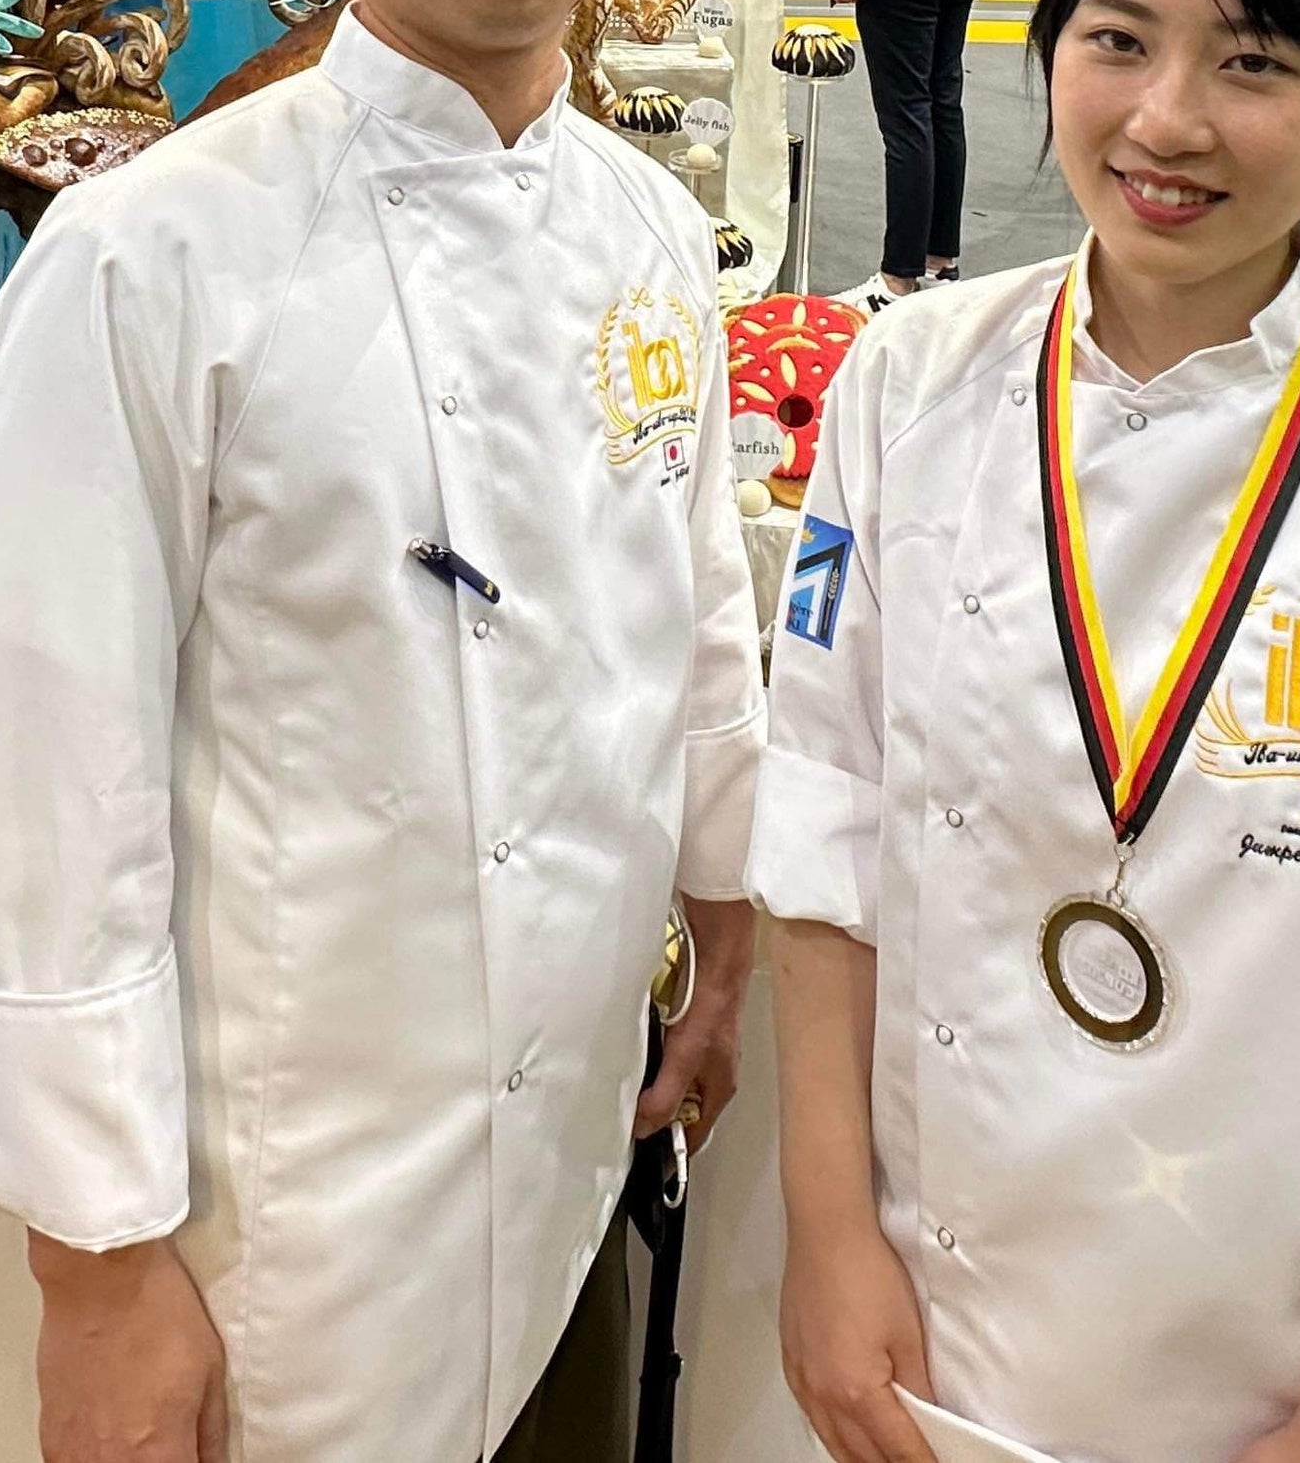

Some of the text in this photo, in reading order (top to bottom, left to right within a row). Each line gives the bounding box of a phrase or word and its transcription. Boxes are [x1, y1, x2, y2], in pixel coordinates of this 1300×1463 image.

[684, 114, 730, 132] Jelly fish
[731, 441, 781, 456] tarfish
